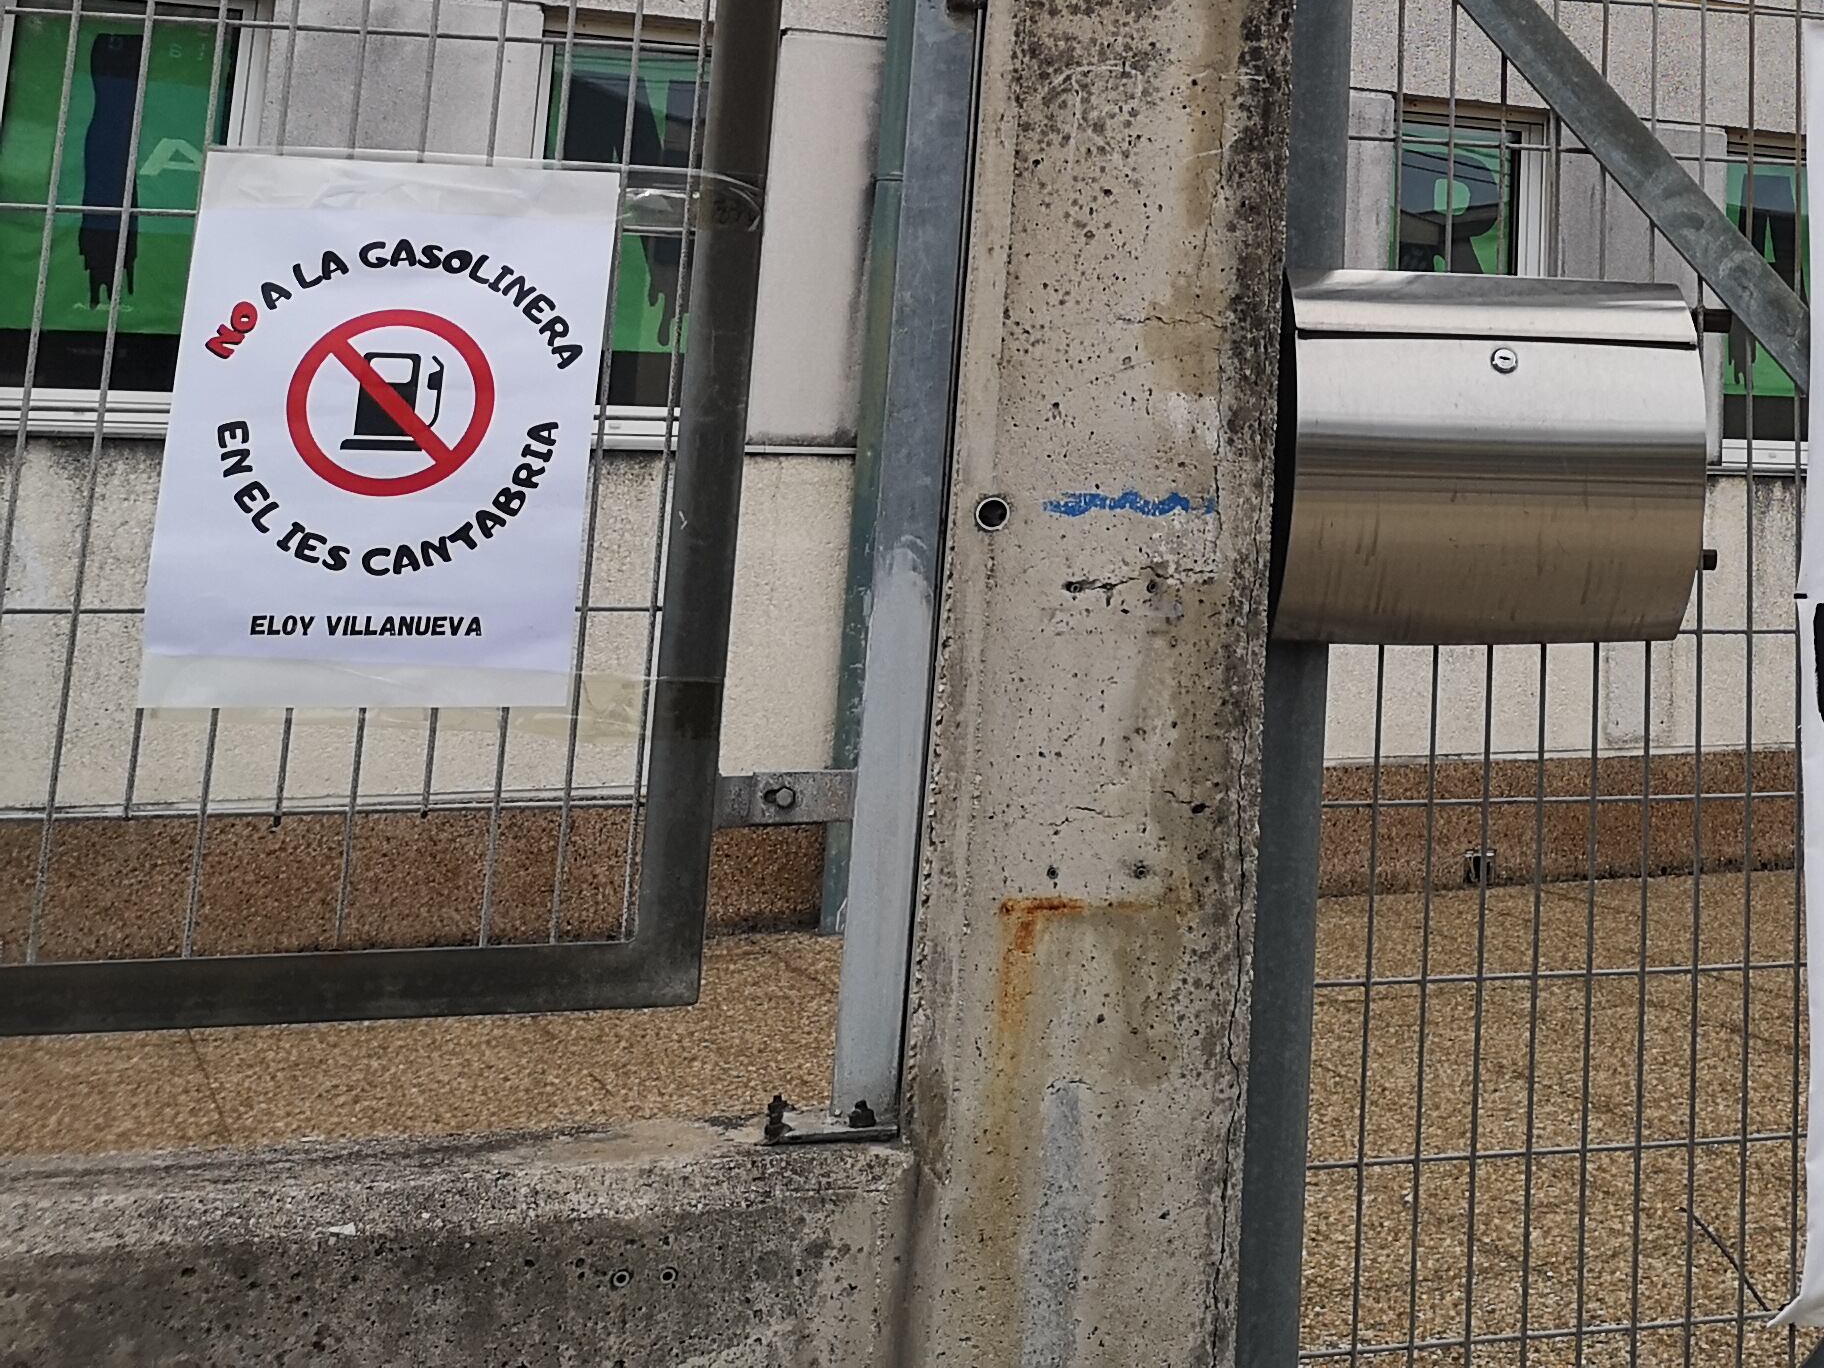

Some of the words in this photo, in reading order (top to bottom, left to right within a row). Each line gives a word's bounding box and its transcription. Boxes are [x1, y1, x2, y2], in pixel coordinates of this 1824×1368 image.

[204, 300, 259, 361] NO
[260, 281, 292, 311] A
[292, 249, 350, 289] LA
[359, 238, 584, 370] GASOLINERA
[216, 419, 254, 479] EN
[233, 480, 280, 534] EL
[360, 421, 560, 576] CANTABRIA
[276, 521, 351, 574] IES
[249, 615, 315, 637] ELOY
[326, 615, 483, 638] VILLANUEVA
